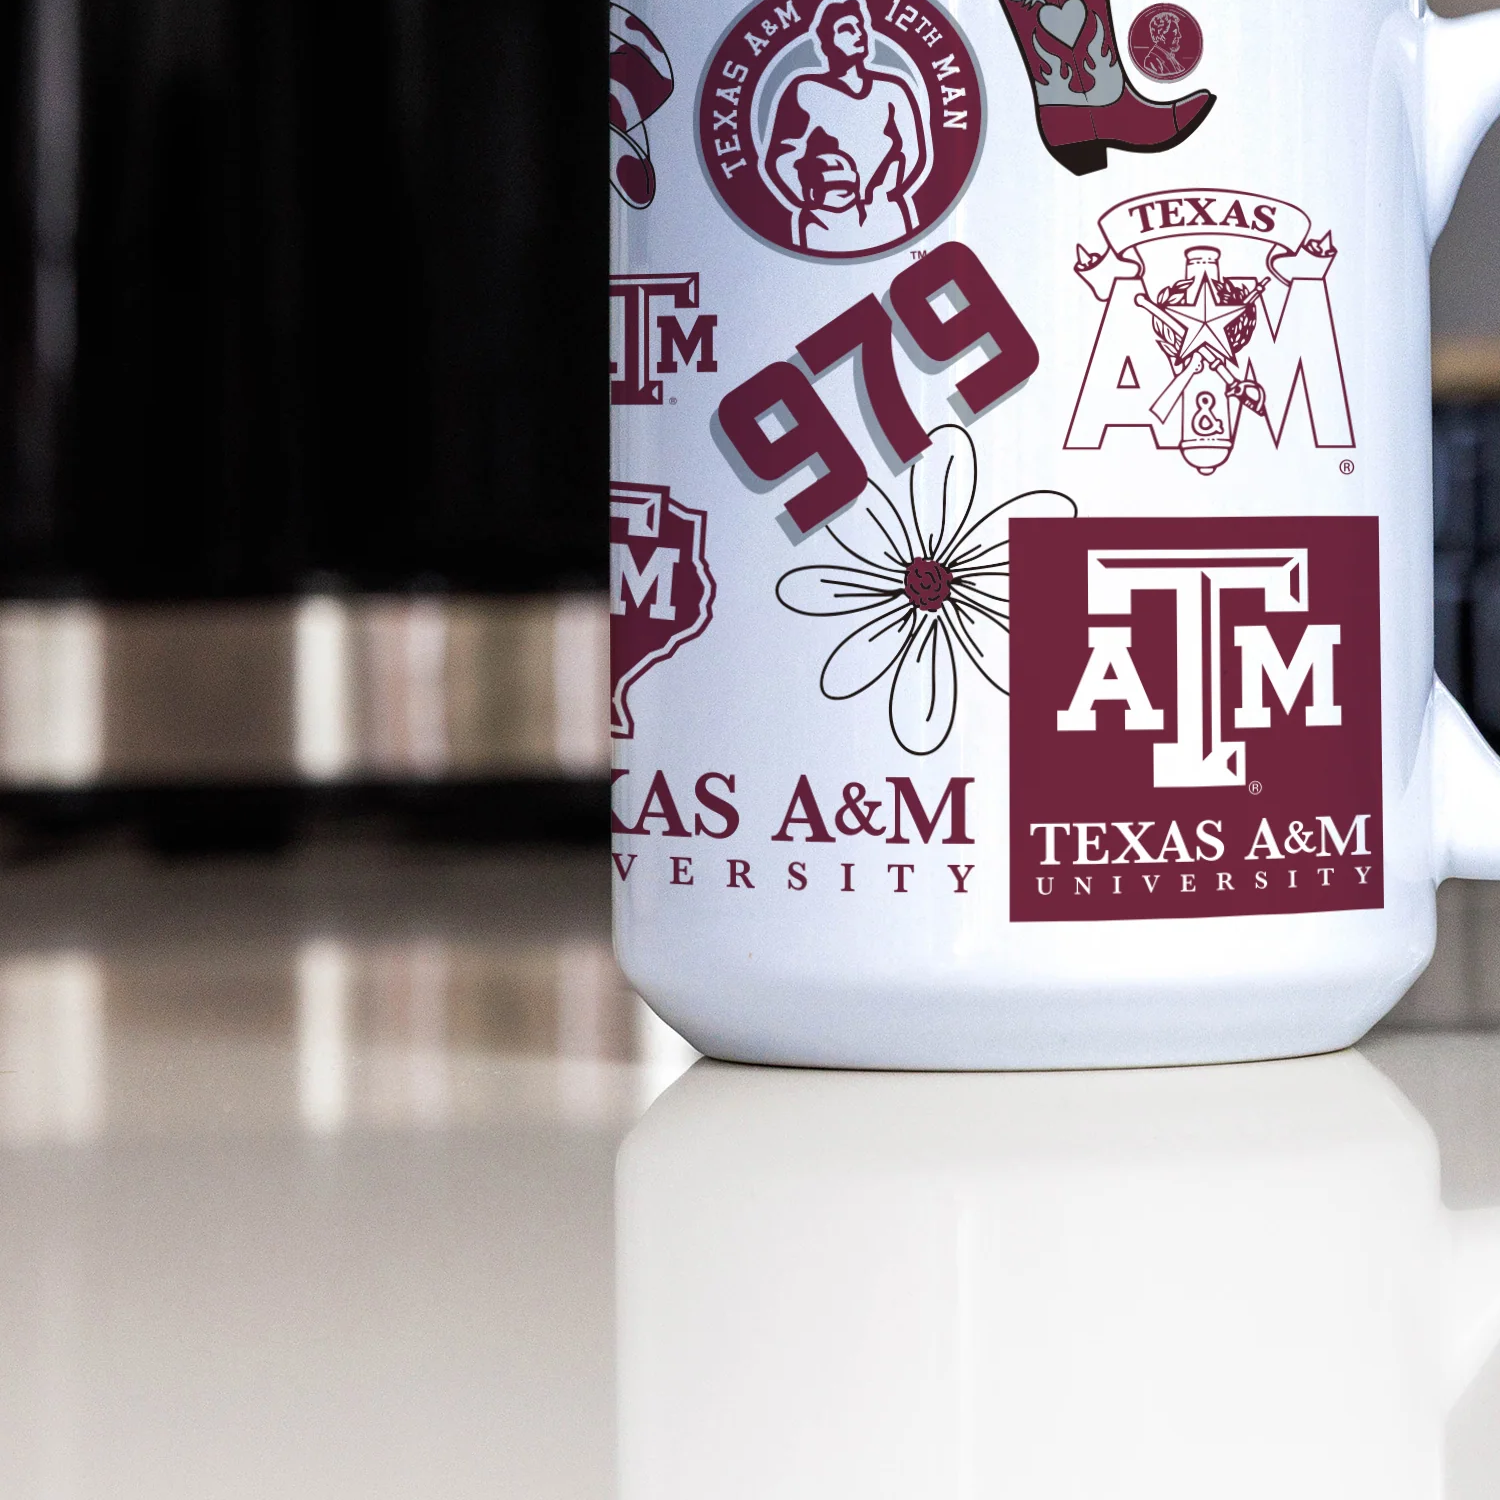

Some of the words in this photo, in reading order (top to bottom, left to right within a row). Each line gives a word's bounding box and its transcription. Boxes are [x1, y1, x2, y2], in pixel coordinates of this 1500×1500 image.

[713, 60, 749, 179] TEXAS
[744, 0, 802, 56] A&M
[931, 53, 968, 131] MAN
[1129, 197, 1277, 234] TEXAS
[711, 241, 1040, 546] 979
[771, 774, 976, 845] A&M
[1030, 819, 1225, 866] TEXAS
[1244, 814, 1372, 861] A&M
[1036, 866, 1372, 896] UNIVERSITY
